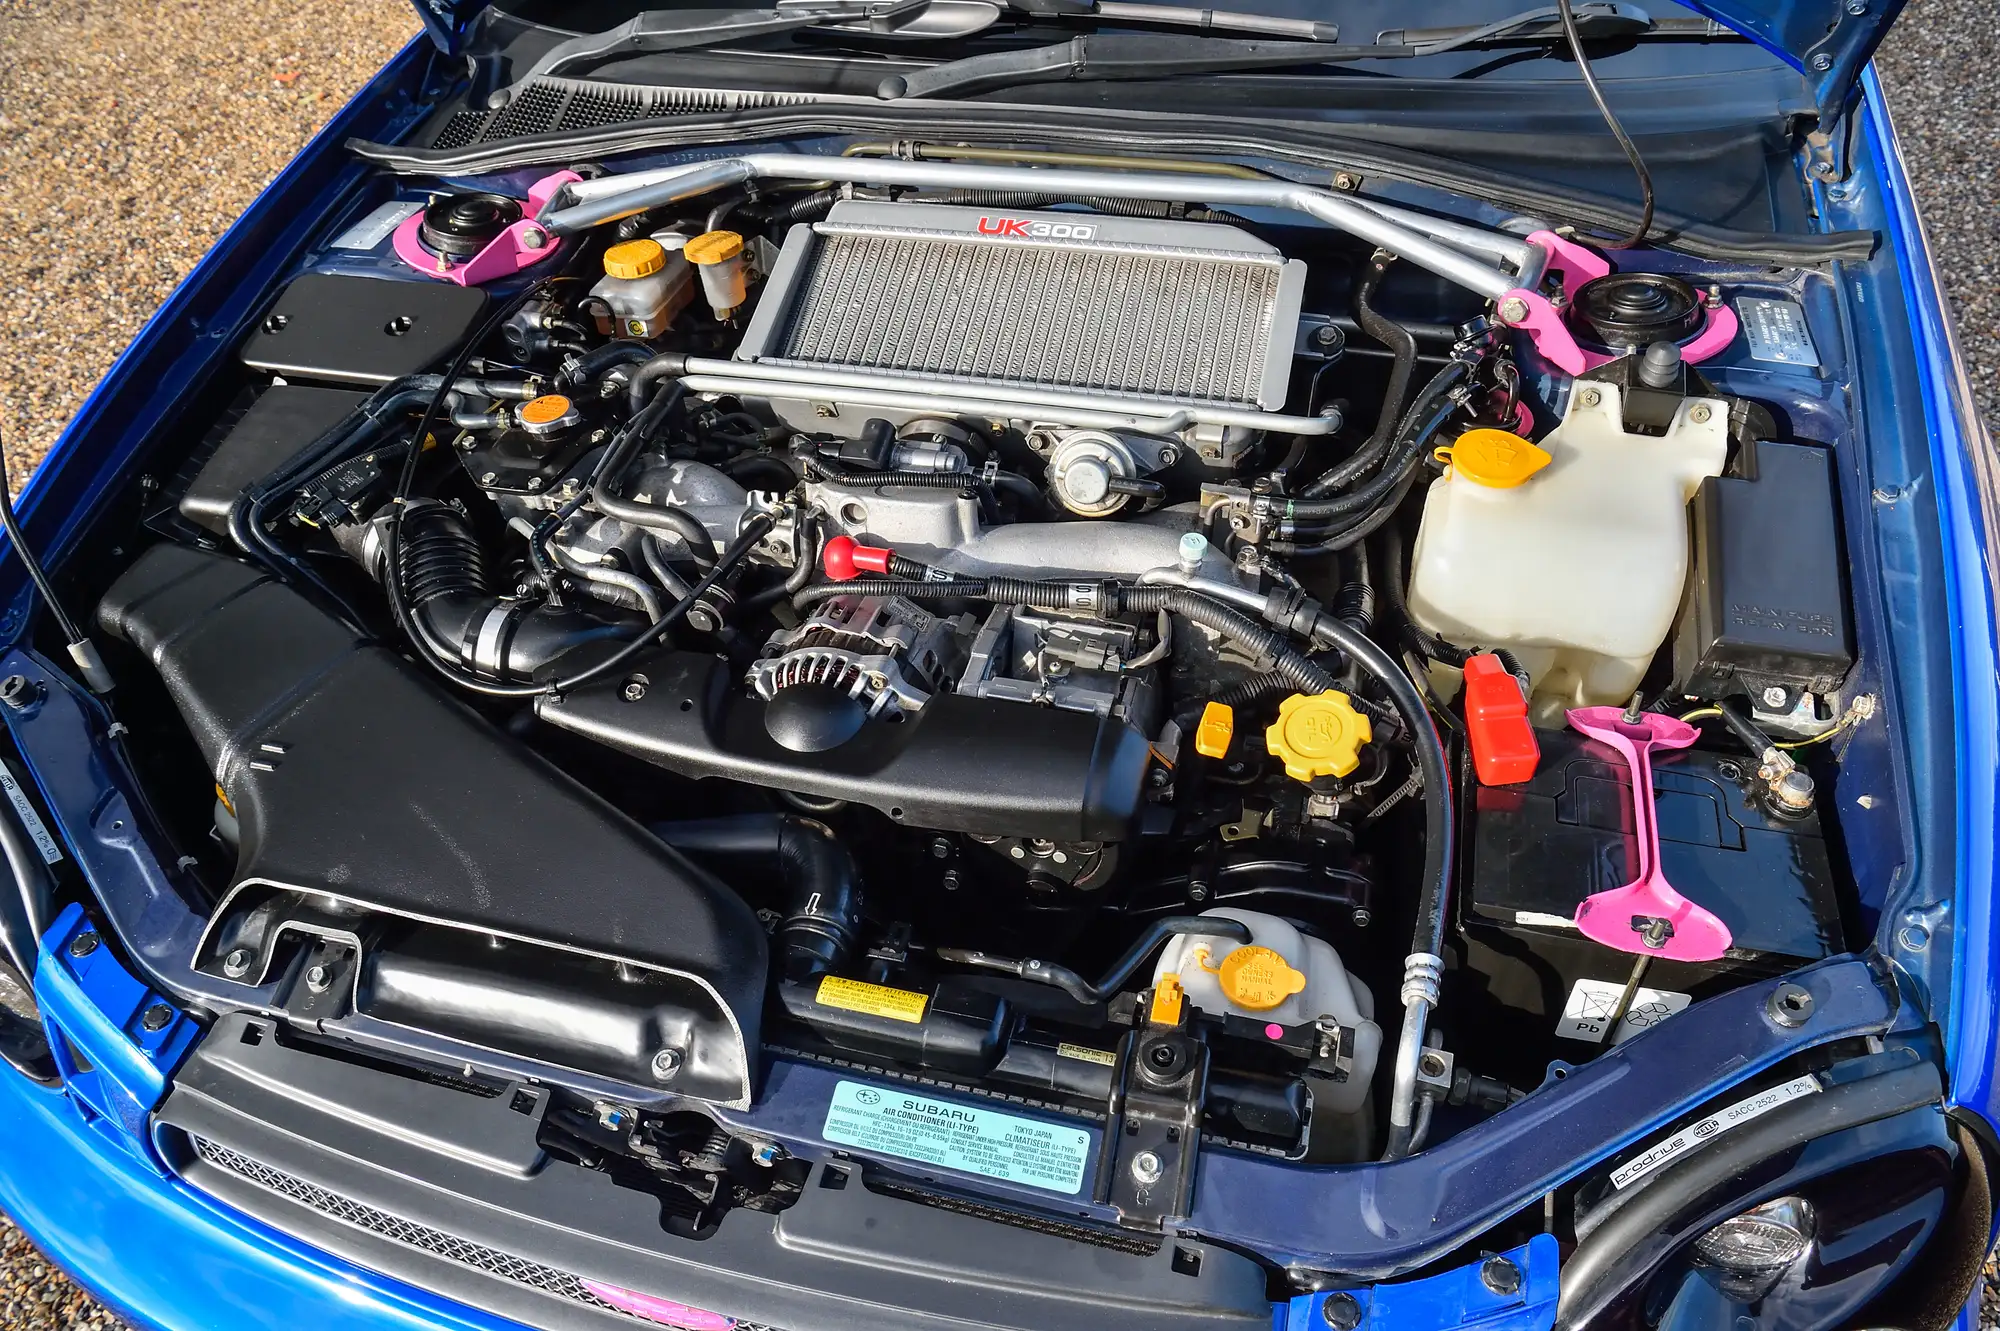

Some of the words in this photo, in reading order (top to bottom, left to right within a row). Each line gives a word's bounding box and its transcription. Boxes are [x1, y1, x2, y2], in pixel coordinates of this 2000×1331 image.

[977, 216, 1092, 239] UK300
[1732, 604, 1782, 617] MAIN
[1732, 616, 1790, 630] RELAY
[1797, 624, 1835, 637] BOX
[13, 794, 28, 812] SACC
[24, 811, 37, 827] 2522
[36, 830, 51, 849] 1.2%
[850, 982, 881, 991] CAUTION
[884, 989, 923, 999] ATTENTION
[1576, 1022, 1600, 1033] Pb
[883, 1107, 896, 1116] AIR
[897, 1111, 946, 1126] CONDITIONER
[946, 1121, 979, 1134] (LI-TYPE)
[902, 1100, 976, 1123] SUBARU
[1005, 1133, 1050, 1149] CLIMATISEUR
[1014, 1125, 1032, 1135] TOKYO
[1034, 1130, 1053, 1140] JAPAN
[1077, 1136, 1084, 1144] S
[1614, 1138, 1686, 1185] prodrive
[1727, 1103, 1755, 1120] SACC
[1756, 1094, 1778, 1109] 2522
[1784, 1081, 1812, 1097] 1.2%
